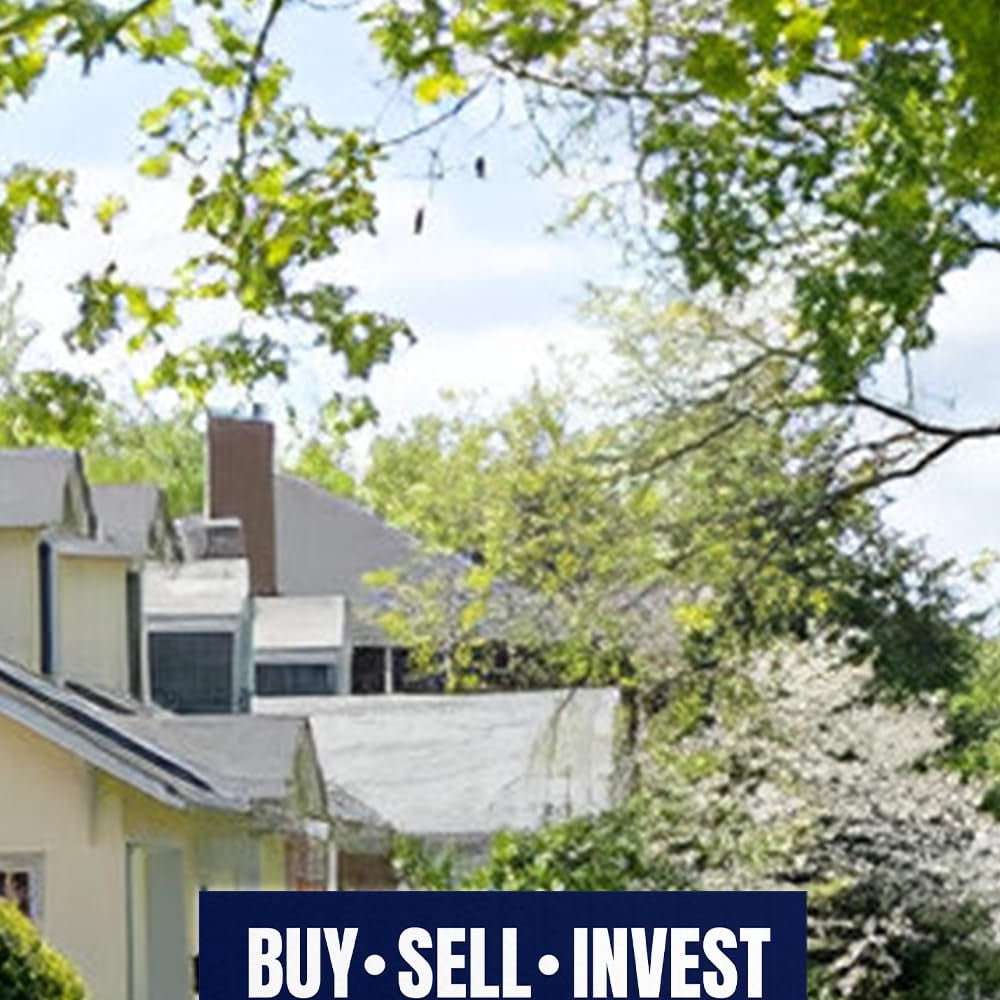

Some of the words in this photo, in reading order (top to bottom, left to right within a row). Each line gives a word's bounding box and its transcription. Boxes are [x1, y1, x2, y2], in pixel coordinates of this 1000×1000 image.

[248, 927, 359, 999] BUY
[398, 926, 532, 999] SELL
[573, 926, 771, 999] INVEST
